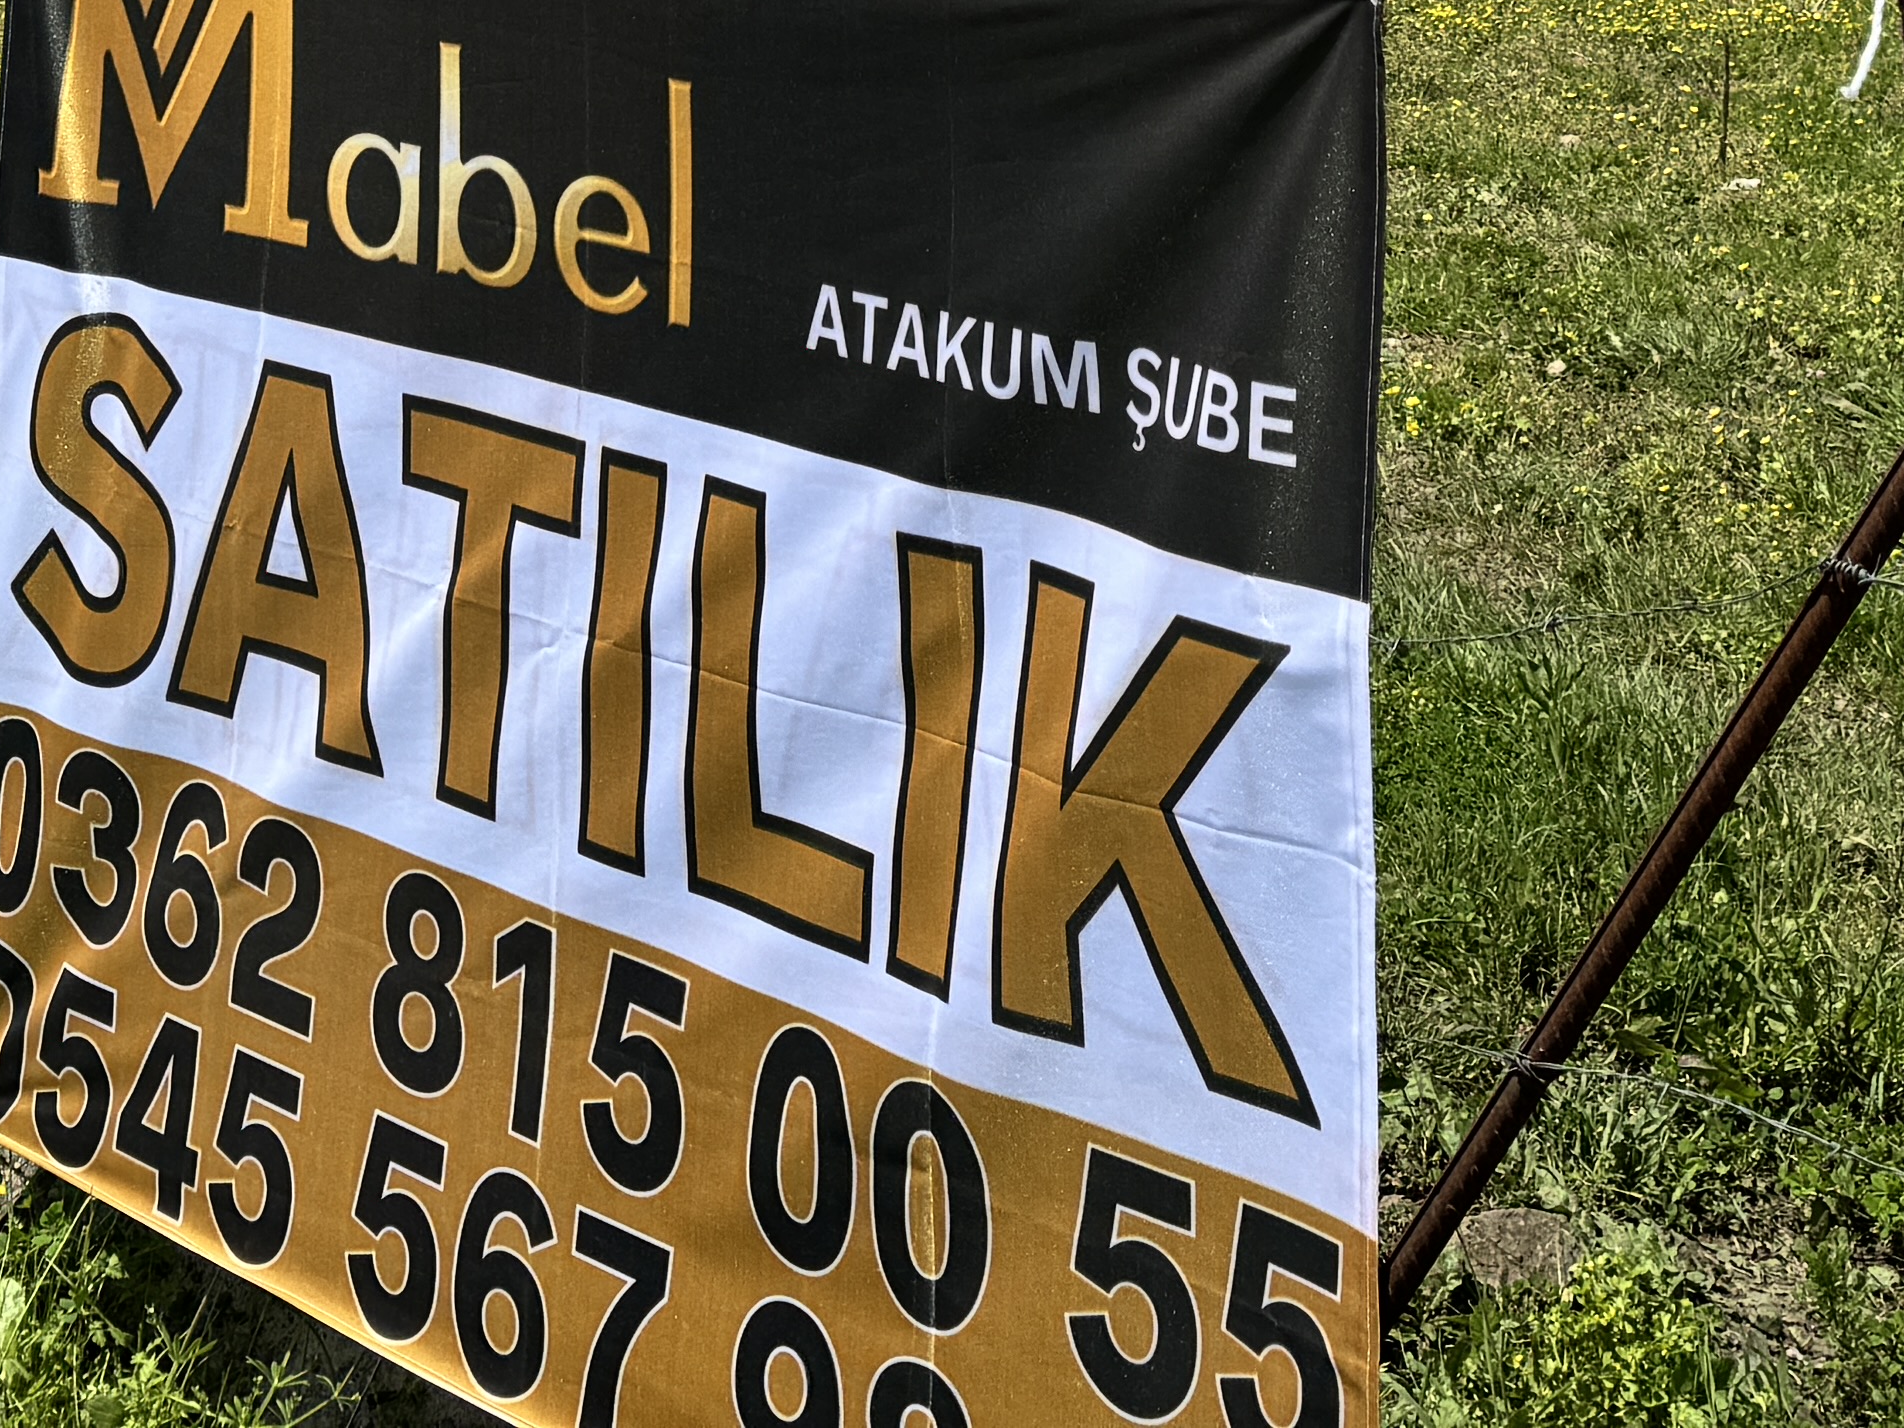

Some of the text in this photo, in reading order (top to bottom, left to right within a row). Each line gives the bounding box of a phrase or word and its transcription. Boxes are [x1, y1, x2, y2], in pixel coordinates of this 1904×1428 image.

[805, 282, 1299, 469] ATAKUM ŞUBE
[12, 312, 1320, 1130] SATILIK
[344, 1109, 674, 1428] 567
[731, 1295, 972, 1428] 9
[371, 870, 691, 1197] 815
[747, 1023, 992, 1336] 00
[1064, 1142, 1343, 1428] 55
